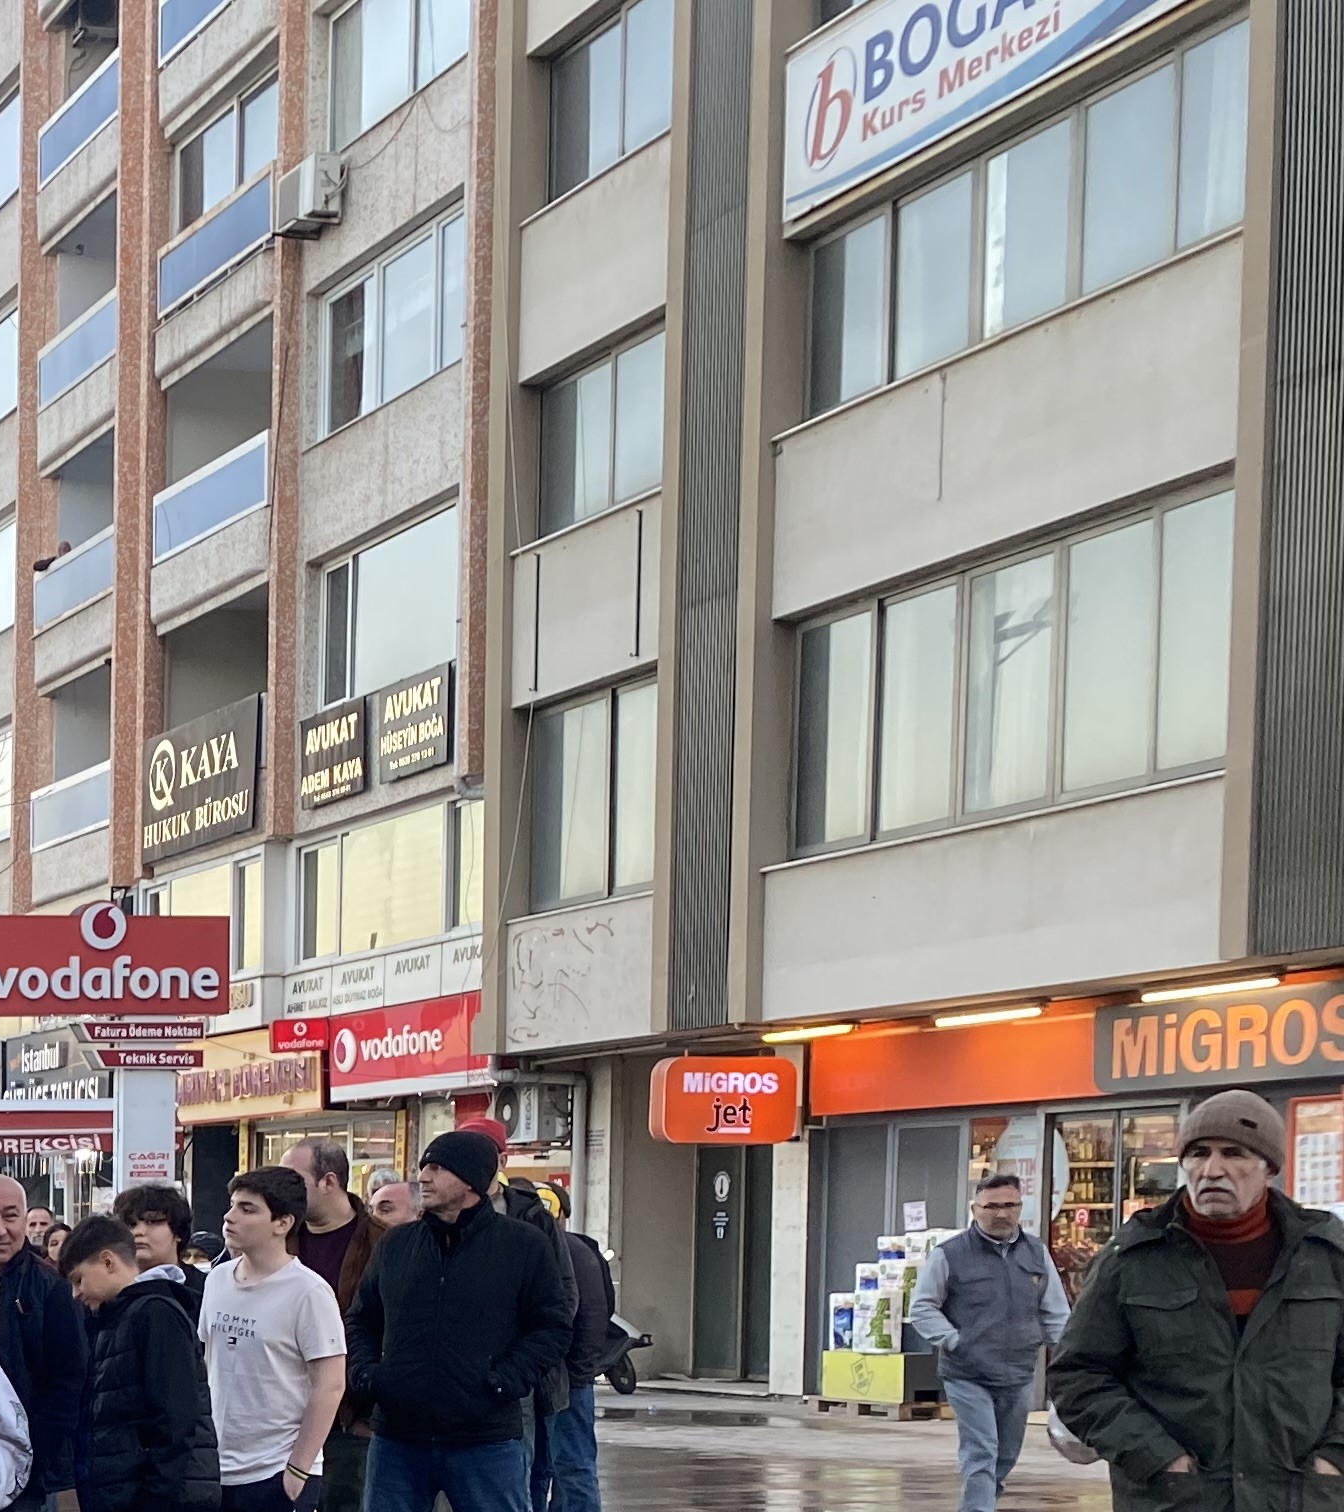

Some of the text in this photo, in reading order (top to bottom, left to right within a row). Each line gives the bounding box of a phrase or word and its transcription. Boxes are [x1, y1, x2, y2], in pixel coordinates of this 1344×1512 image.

[860, 1, 1061, 143] Kurs Merkezi
[384, 676, 442, 724] AVUKAT
[305, 712, 358, 756] AVUKAT
[380, 713, 444, 757] HÜSEYİN BOĞA
[179, 731, 239, 789] KAYA
[300, 768, 330, 797] ADEM
[332, 756, 363, 785] KAYA
[143, 788, 249, 849] HUKUK BÜROSU
[340, 966, 375, 986] AVUKAT
[395, 955, 431, 975] AVUKAT
[292, 977, 324, 995] AVUKAT
[94, 1023, 201, 1039] Fatura Ödeme Noktası
[277, 1038, 325, 1050] vodafone
[360, 1024, 443, 1061] vodafone
[21, 1042, 60, 1074] İstanbul
[118, 1052, 195, 1065] Teknik Servis
[706, 1097, 752, 1132] jet
[210, 1321, 256, 1338] HILFIGER
[216, 1311, 257, 1328] TOMMY
